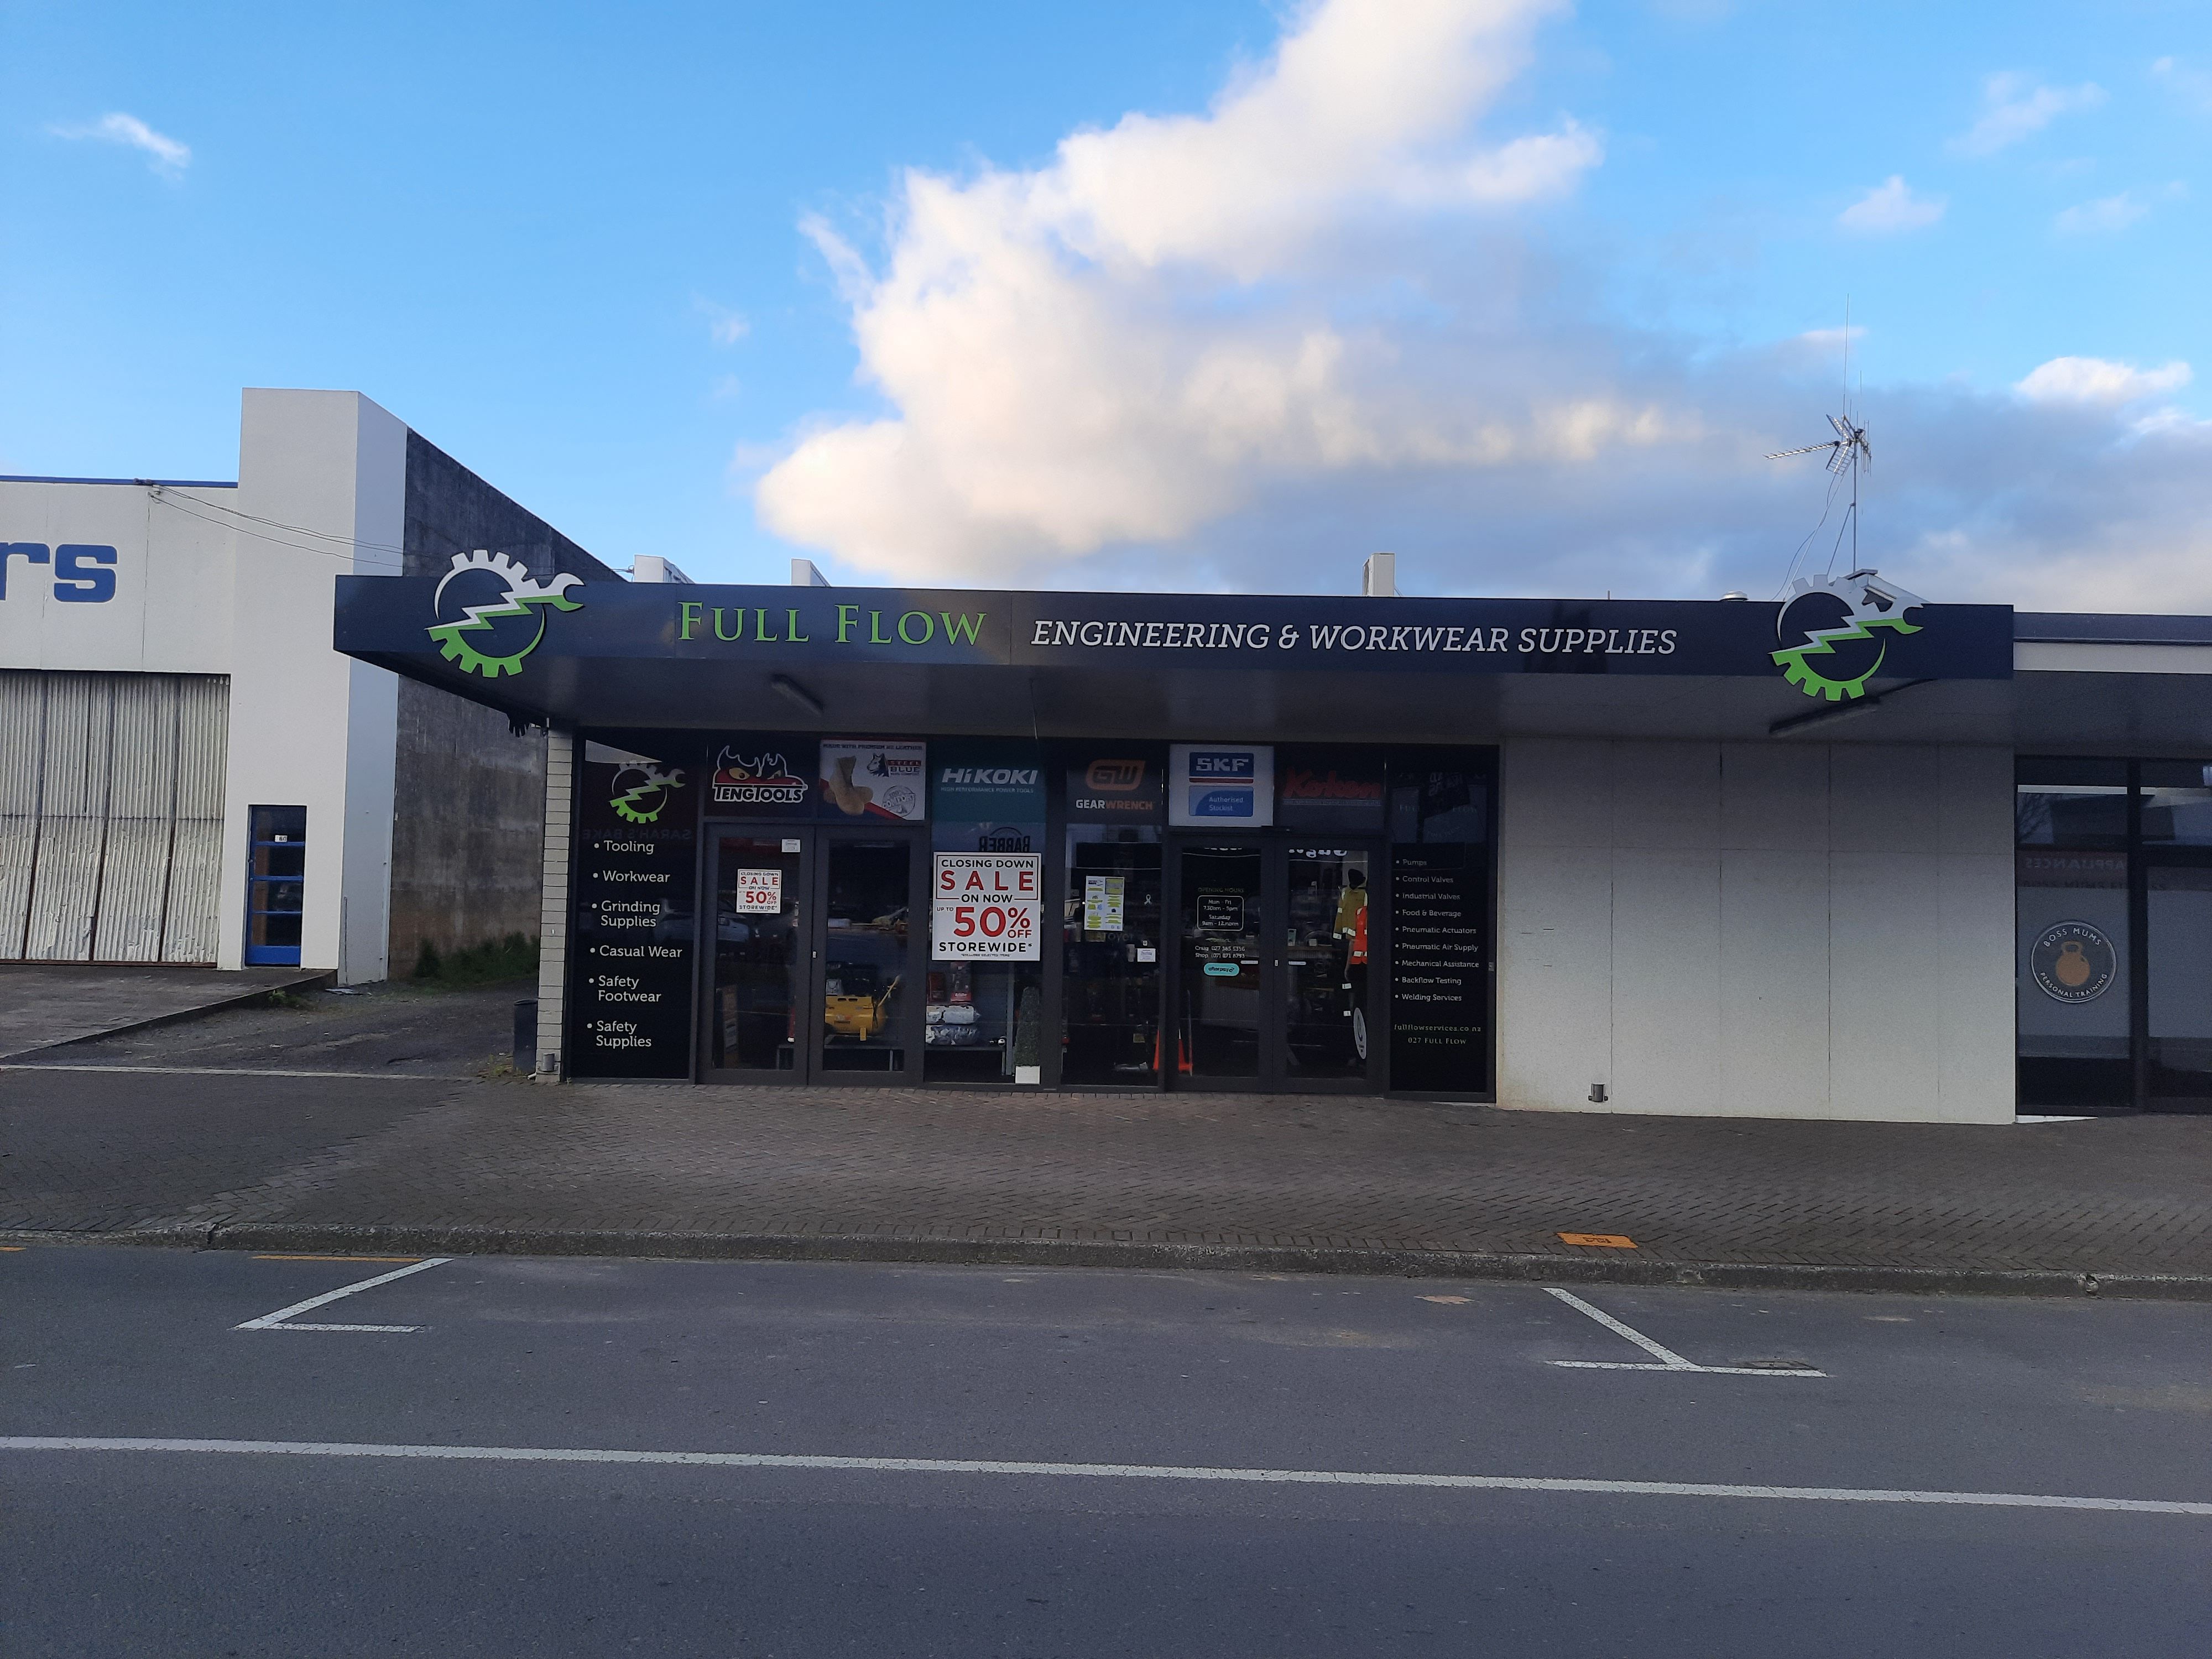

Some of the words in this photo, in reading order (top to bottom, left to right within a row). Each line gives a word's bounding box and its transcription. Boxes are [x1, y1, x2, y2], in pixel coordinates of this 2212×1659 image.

[677, 601, 810, 642] FULL
[834, 604, 988, 646] FLOW
[1031, 620, 1270, 649] ENGINEERING
[1277, 625, 1300, 649] &
[1309, 625, 1510, 653] WORKWEAR
[1517, 628, 1678, 656] SUPPLIES
[1196, 758, 1249, 771] SKF
[603, 840, 654, 855] Tooling
[941, 859, 992, 868] CLOSING
[603, 870, 670, 883] Workwear
[740, 877, 778, 885] SALE
[941, 870, 1034, 891] SALE
[745, 891, 776, 904] 50%
[962, 894, 979, 902] ON
[983, 894, 1013, 903] NOW
[601, 900, 660, 915] Grinding
[1429, 910, 1462, 918] Beverage
[601, 915, 657, 930] Supplies
[953, 906, 1030, 937] 50%
[1008, 930, 1032, 938] OFF
[2043, 928, 2068, 947] BOSS
[2073, 927, 2102, 946] MUMS
[599, 946, 644, 958] Casual
[648, 946, 682, 958] Wear
[1454, 944, 1479, 952] Supply
[598, 975, 639, 989] Safety
[1436, 977, 1462, 985] Testing
[2041, 972, 2073, 998] PERSONAL
[2074, 973, 2108, 997] TRAINING
[598, 990, 661, 1003] Footwear
[597, 1020, 637, 1034] Safety
[596, 1035, 651, 1050] Supplies
